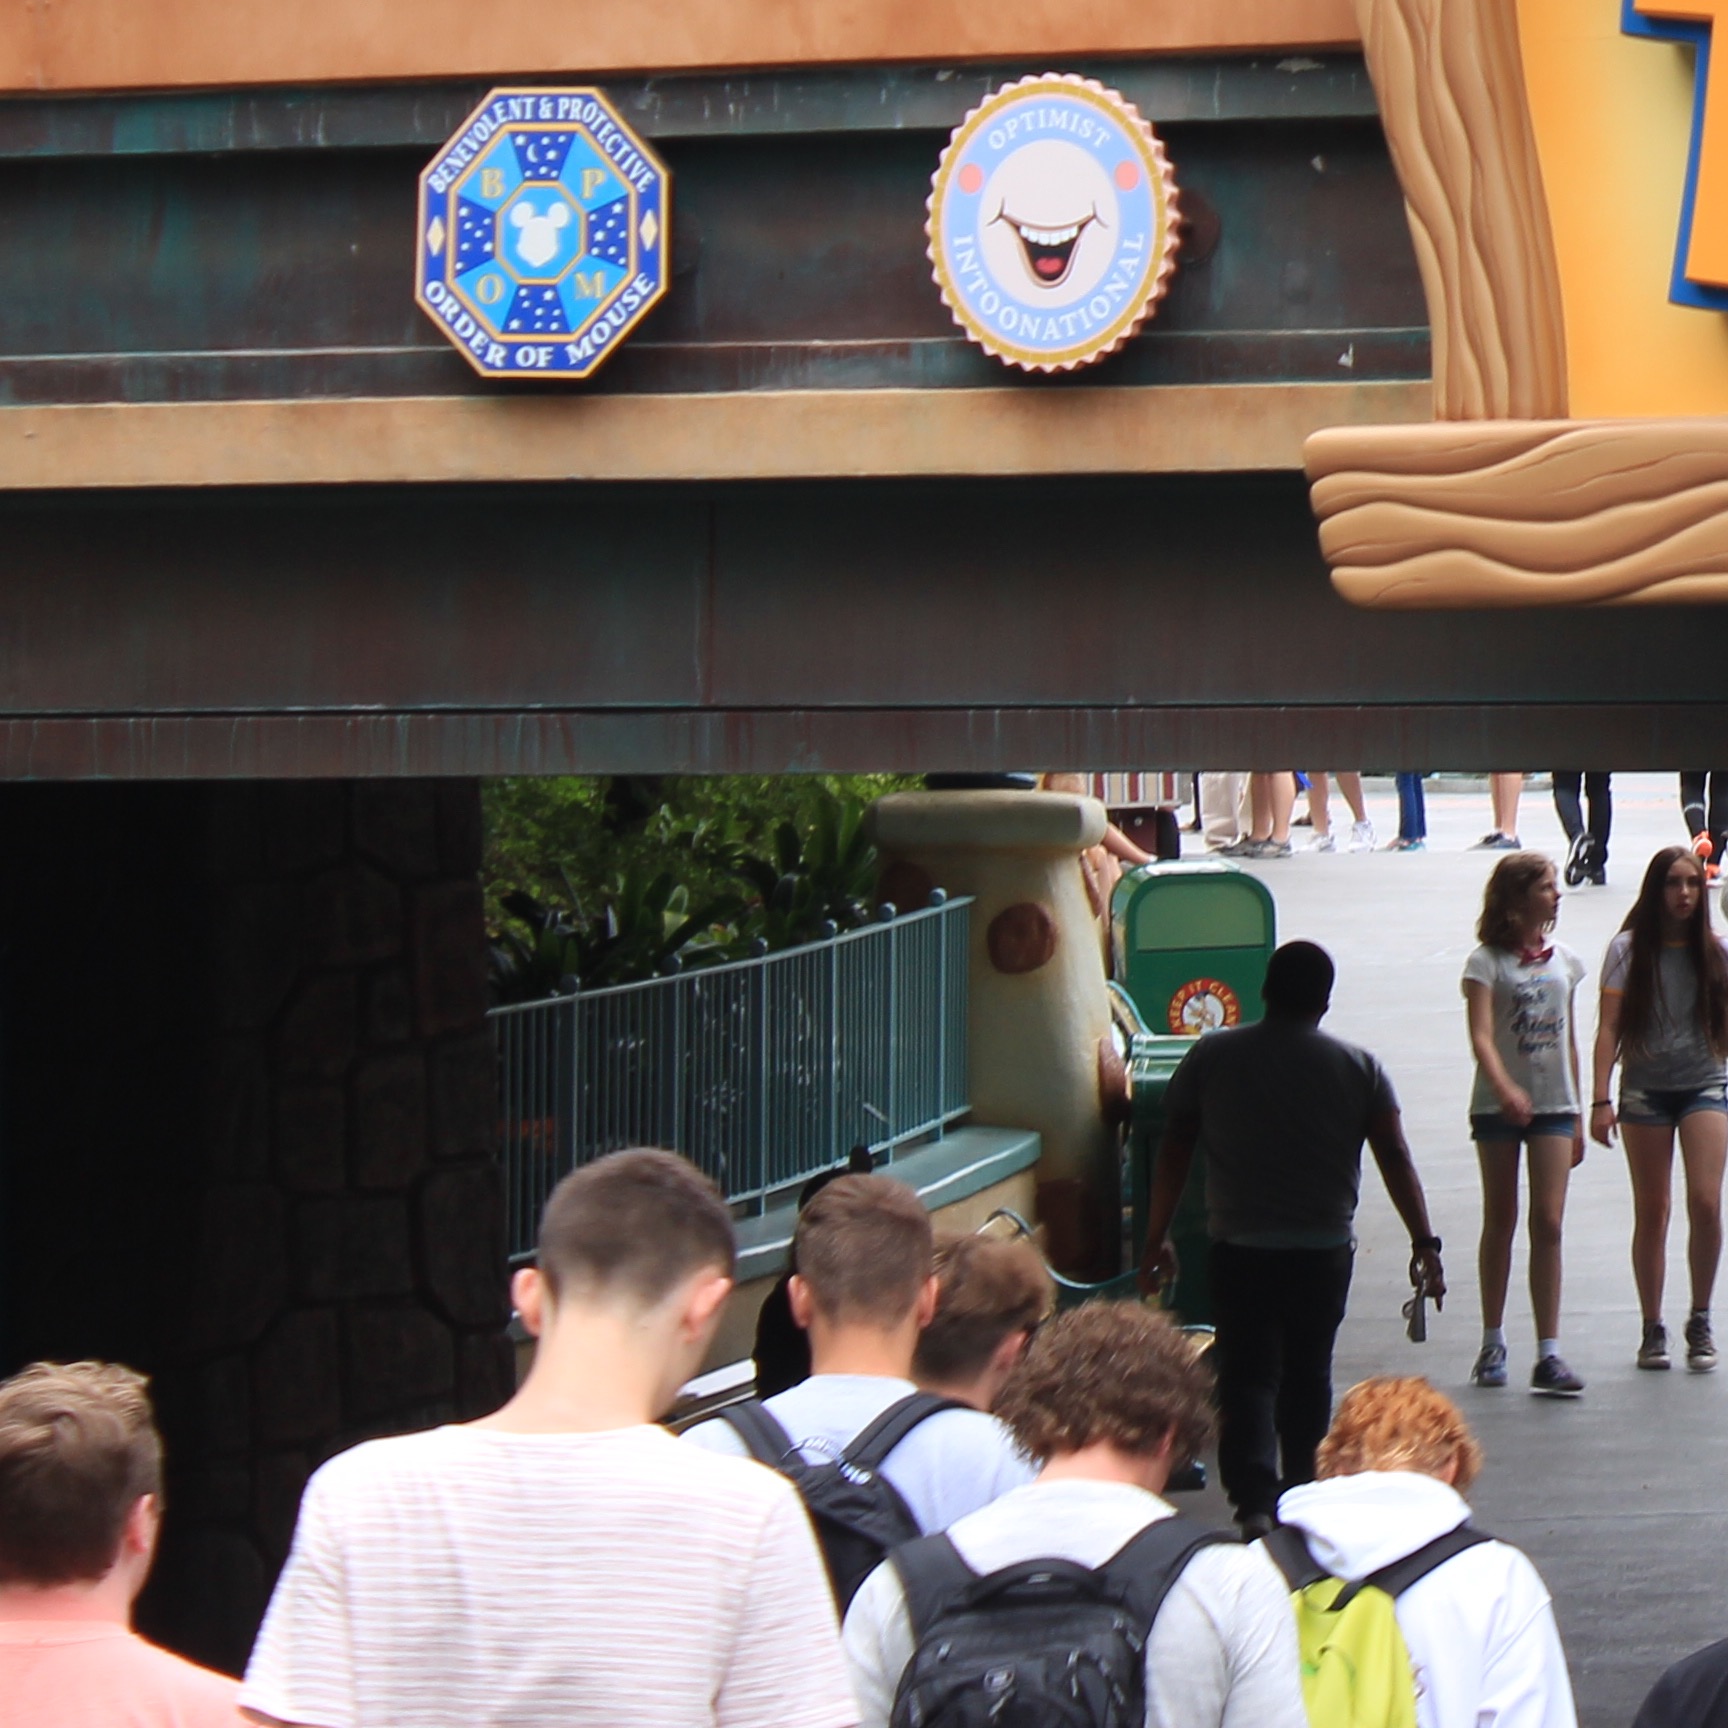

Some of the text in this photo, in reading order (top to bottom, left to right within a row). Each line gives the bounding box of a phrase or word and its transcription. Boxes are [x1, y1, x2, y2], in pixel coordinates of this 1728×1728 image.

[427, 96, 656, 194] BENEVOLENT & PROTECTIVE
[987, 107, 1111, 151] OPTIMIST
[480, 168, 505, 199] B
[581, 168, 608, 199] P
[475, 274, 505, 304] O
[574, 270, 606, 300] M
[953, 232, 1145, 341] INTOONATIONAL
[424, 272, 657, 368] ORDER OF MOUSE
[1168, 988, 1186, 1029] KEEP
[1188, 979, 1203, 994] IT
